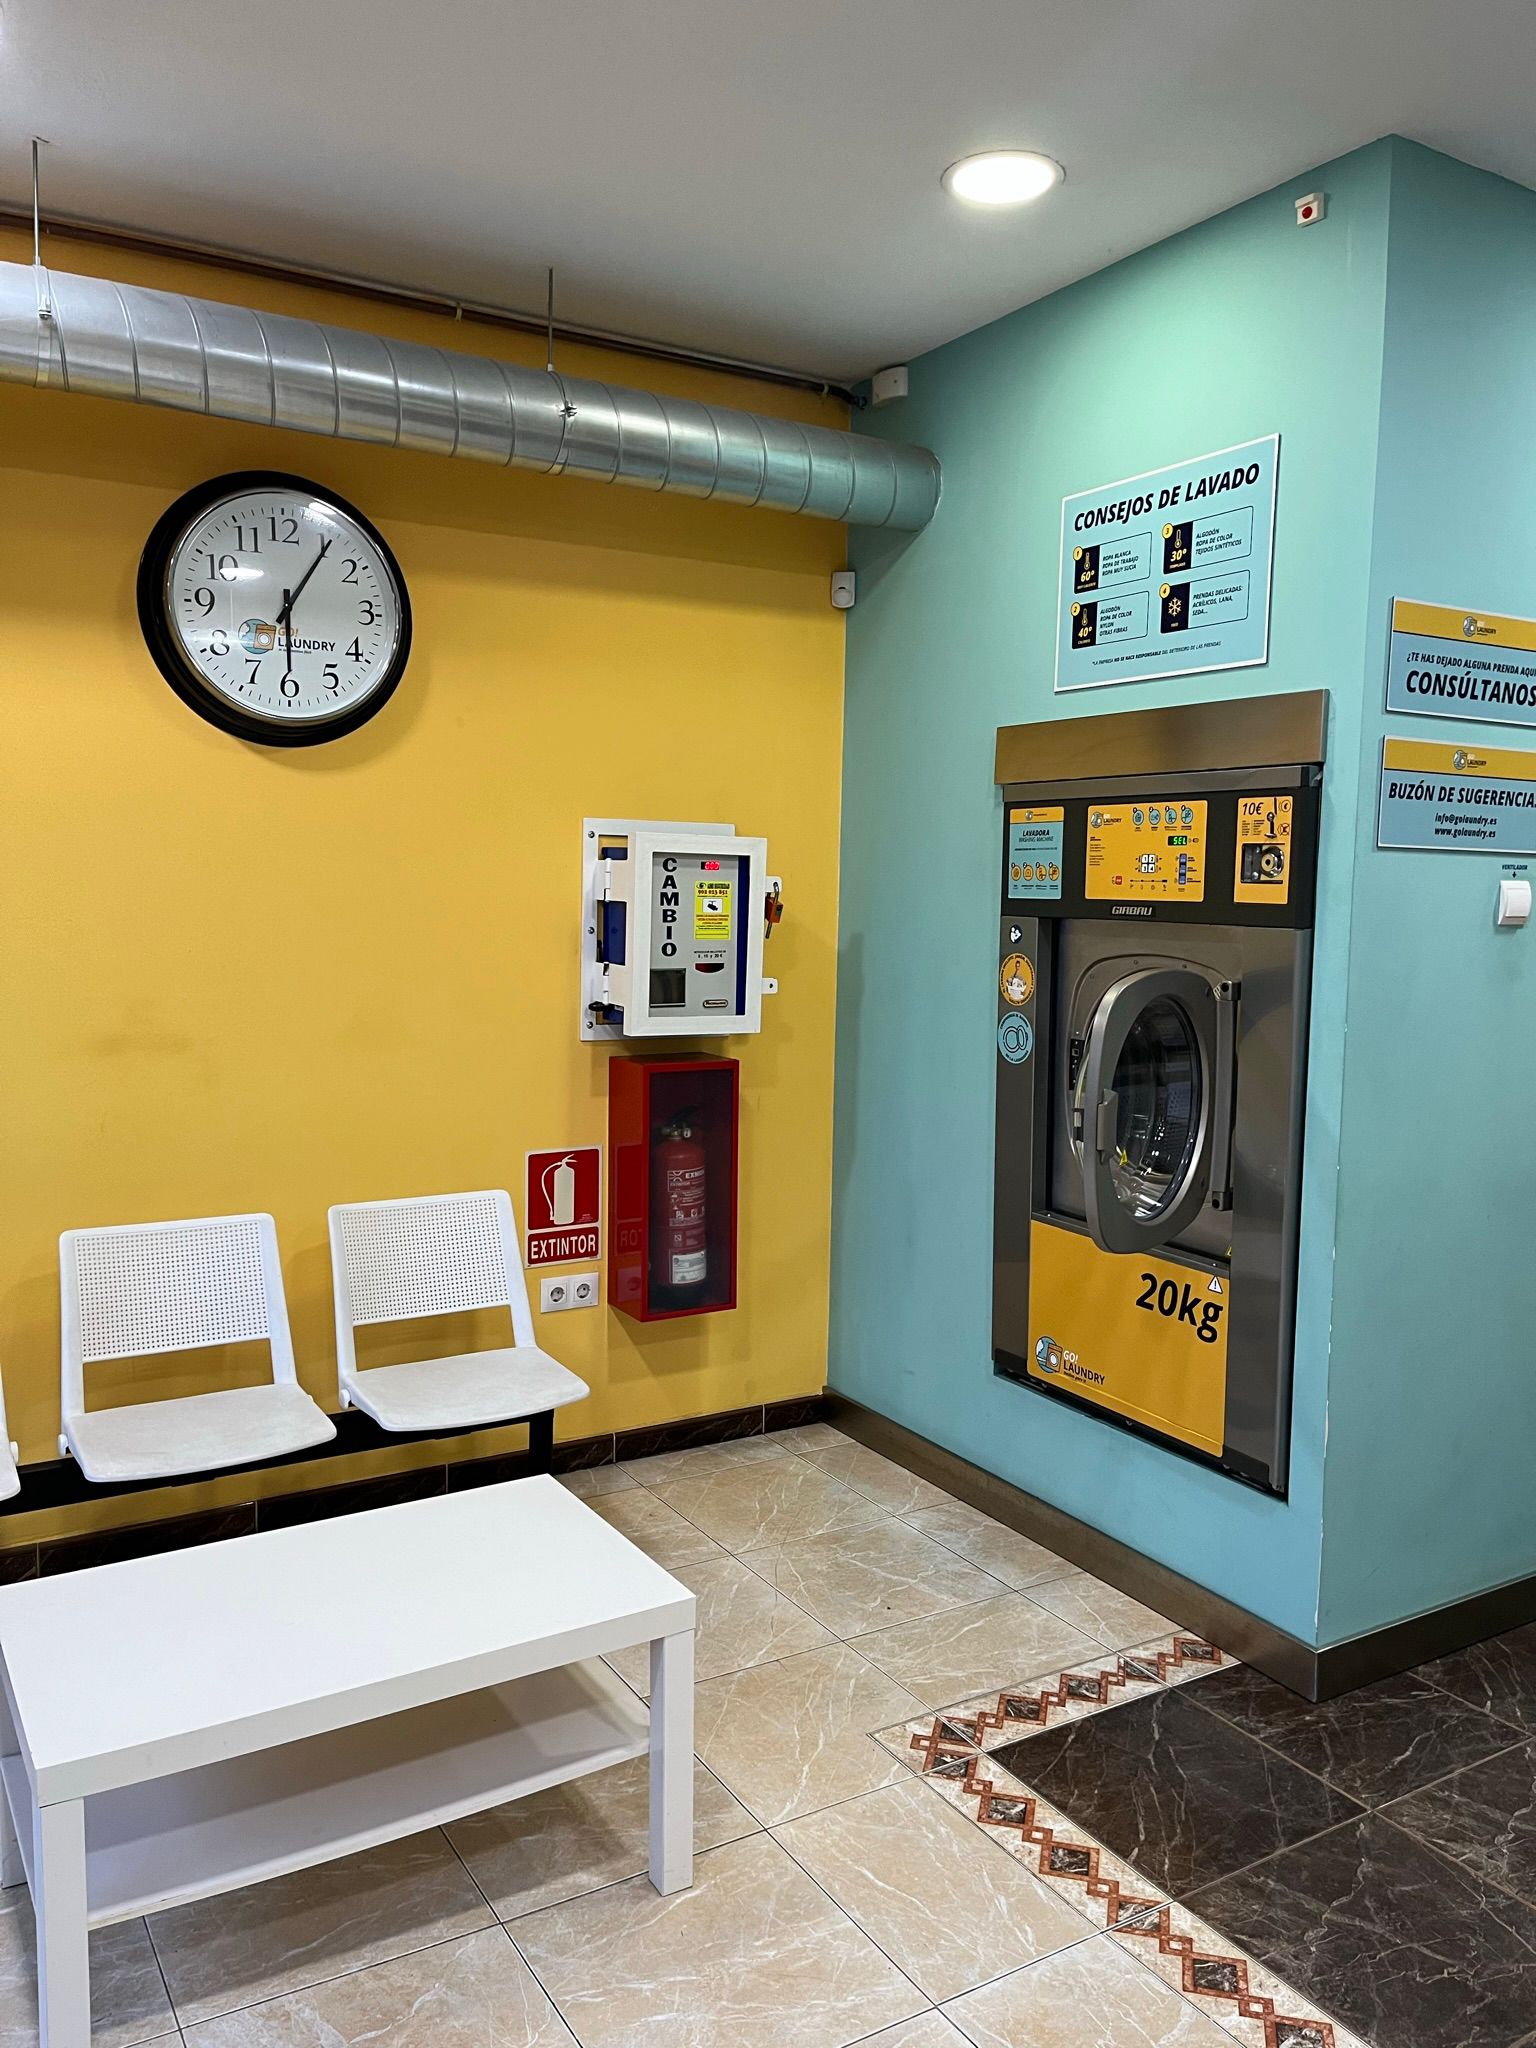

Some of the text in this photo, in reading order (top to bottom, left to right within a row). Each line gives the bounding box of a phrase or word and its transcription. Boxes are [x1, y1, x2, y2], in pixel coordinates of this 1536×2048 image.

[1074, 462, 1260, 532] CONSEJOS DE LAVADO
[236, 526, 262, 554] 11
[268, 516, 300, 546] 12
[1216, 533, 1233, 542] COLOR
[1114, 550, 1131, 559] BLANCA
[1120, 555, 1138, 565] TRABAJO
[1196, 539, 1242, 555] TEJIDOS SINTÉTICOS
[206, 554, 238, 582] 10
[340, 559, 359, 585] 2
[194, 587, 216, 617] 9
[1193, 590, 1214, 600] PRENDAS
[357, 600, 375, 625] 3
[210, 629, 230, 656] 8
[278, 637, 336, 652] LAUNDRY
[345, 636, 364, 662] 4
[245, 658, 262, 685] 7
[1407, 652, 1419, 664] ¿TE
[1420, 653, 1435, 664] HAS
[1436, 655, 1462, 668] DEJADO
[1463, 658, 1491, 671] ALGUNA
[1493, 662, 1519, 674] PRENDA
[280, 669, 300, 698] 6
[322, 663, 339, 690] 5
[1406, 670, 1536, 707] CONSÚLTANOS
[1388, 780, 1536, 808] BUZÓN DE SUGERENCIA
[1242, 802, 1264, 815] 10€
[1434, 812, 1497, 826] info@golaundry.es
[1173, 836, 1186, 845] SEL
[1434, 827, 1496, 839] www.golaundry.es
[660, 858, 679, 957] CAMBIO
[1112, 905, 1152, 916] GIRBAU
[530, 1234, 596, 1260] EXTINTOR
[1136, 1272, 1224, 1344] 20kg
[1064, 1350, 1078, 1364] GO!
[1064, 1360, 1105, 1385] LAUNDRY
